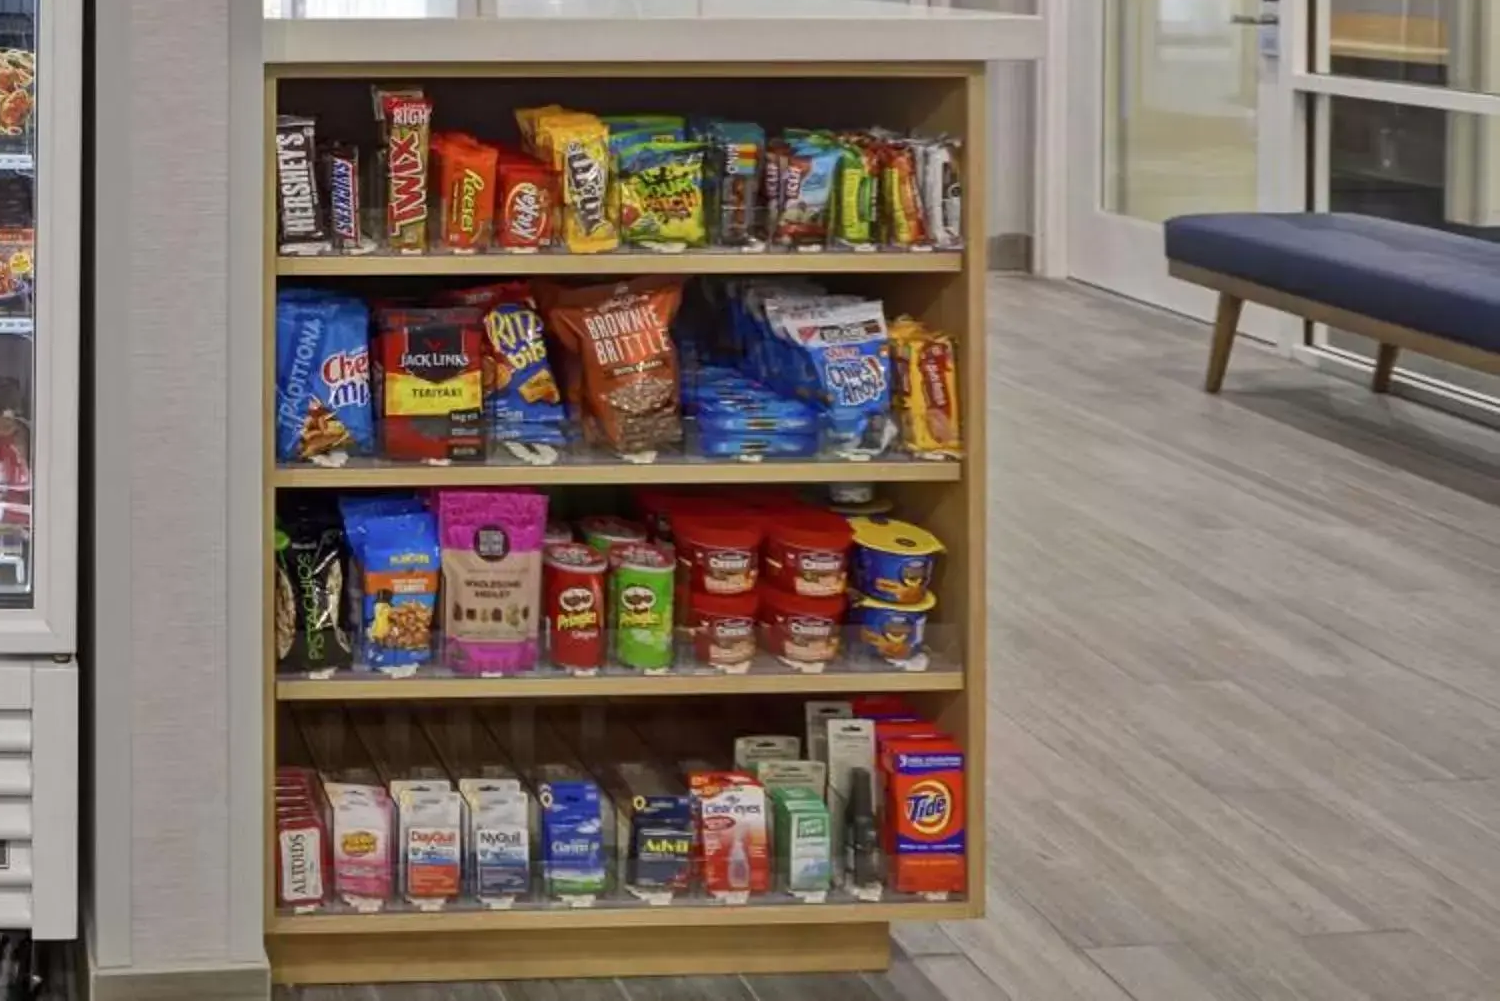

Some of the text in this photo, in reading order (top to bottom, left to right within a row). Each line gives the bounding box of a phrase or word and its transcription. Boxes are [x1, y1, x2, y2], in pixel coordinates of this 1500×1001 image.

[276, 132, 317, 233] HERSHEY'S
[388, 131, 428, 237] TWIX
[584, 304, 662, 341] BROWNIE
[594, 328, 673, 366] BRITTLE
[907, 795, 949, 822] Tide
[288, 833, 307, 894] ALTOIDS
